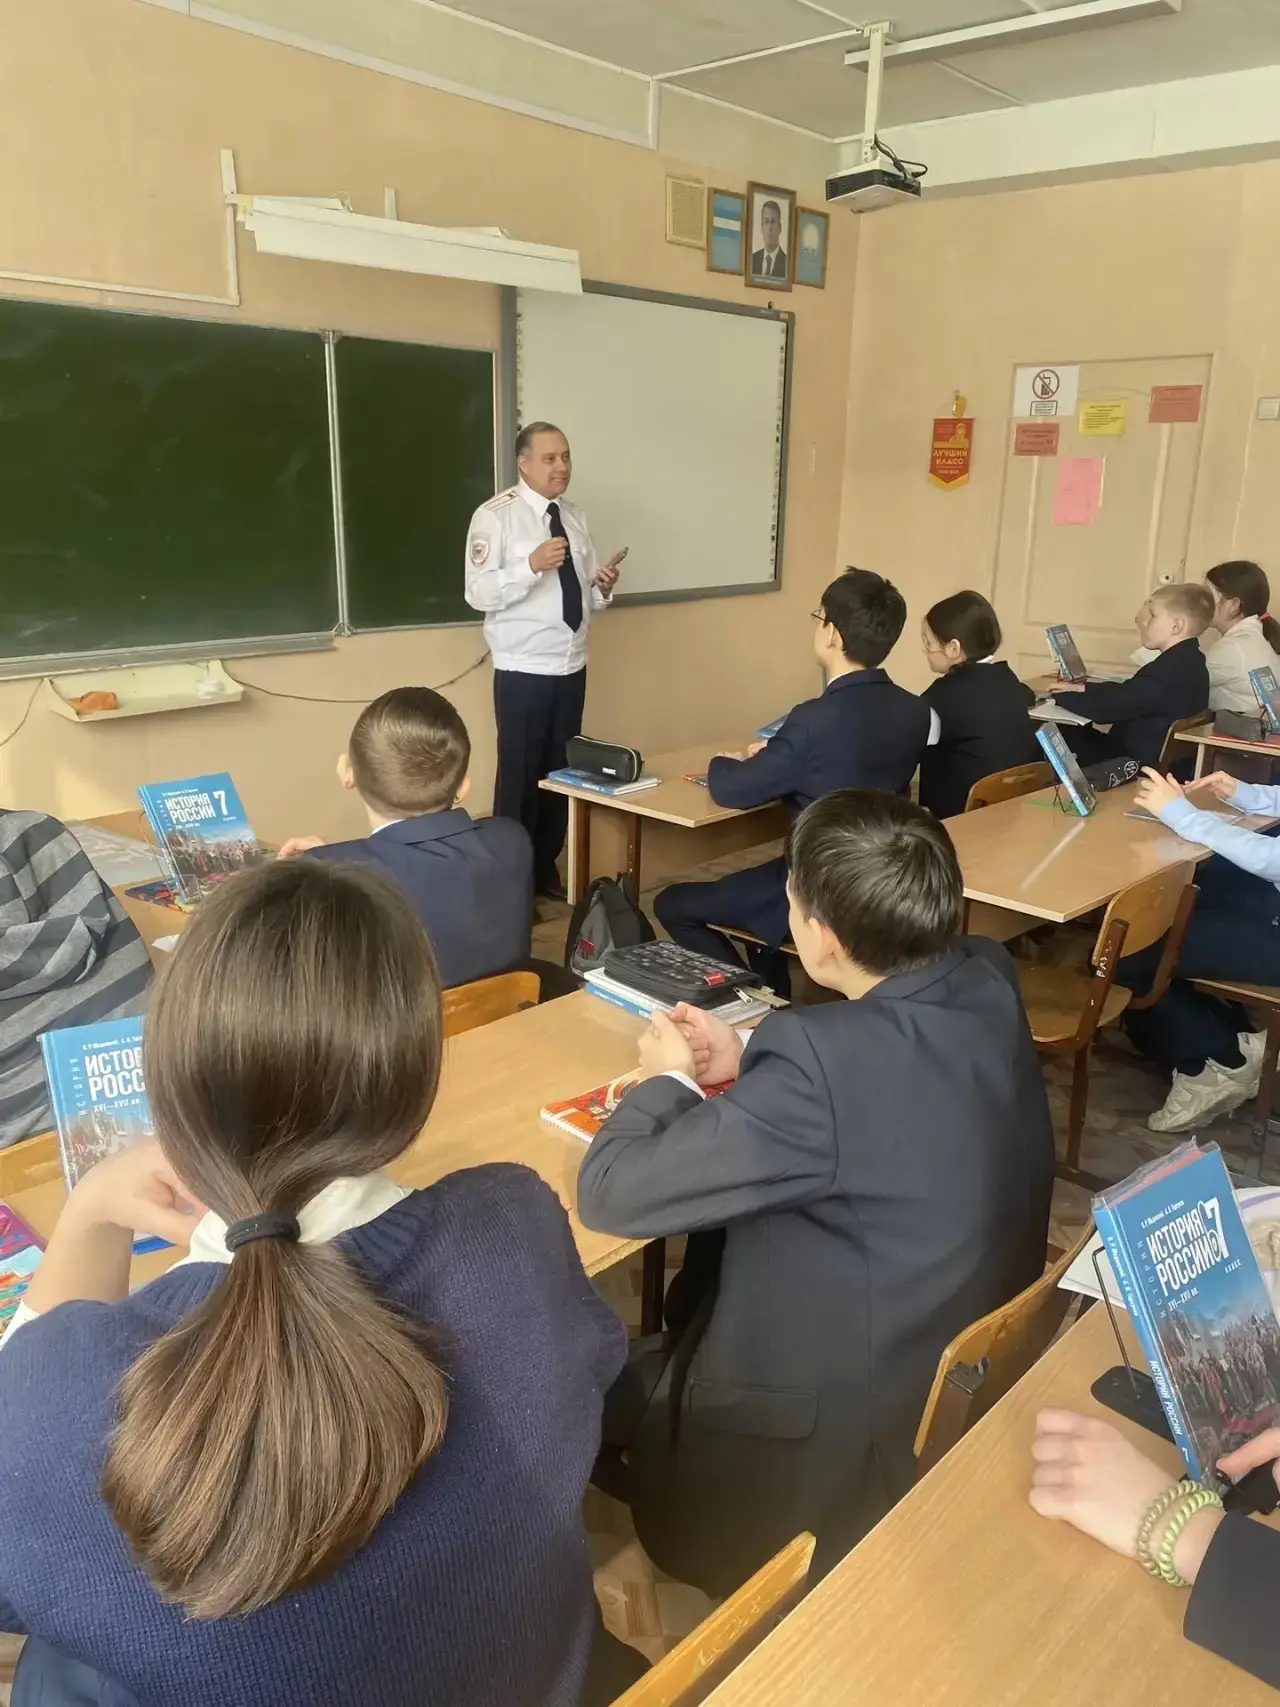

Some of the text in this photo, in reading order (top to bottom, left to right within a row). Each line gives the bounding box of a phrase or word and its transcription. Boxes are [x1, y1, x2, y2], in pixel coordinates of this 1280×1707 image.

[933, 448, 968, 457] ЛУЧШИЙ
[935, 457, 965, 465] КЛАСС
[163, 792, 212, 812] ИСТОРИЯ
[168, 804, 217, 824] РОССИИ
[212, 790, 229, 816] 7
[84, 1046, 143, 1077] ИСТОР
[88, 1068, 146, 1102] РОСС
[1145, 1207, 1205, 1265] ИСТОРИЯ
[1204, 1196, 1230, 1260] 7
[1155, 1234, 1215, 1298] РОССИИ
[1149, 1359, 1169, 1399] ИСТОРИЯ
[1164, 1398, 1183, 1436] РОССИИ
